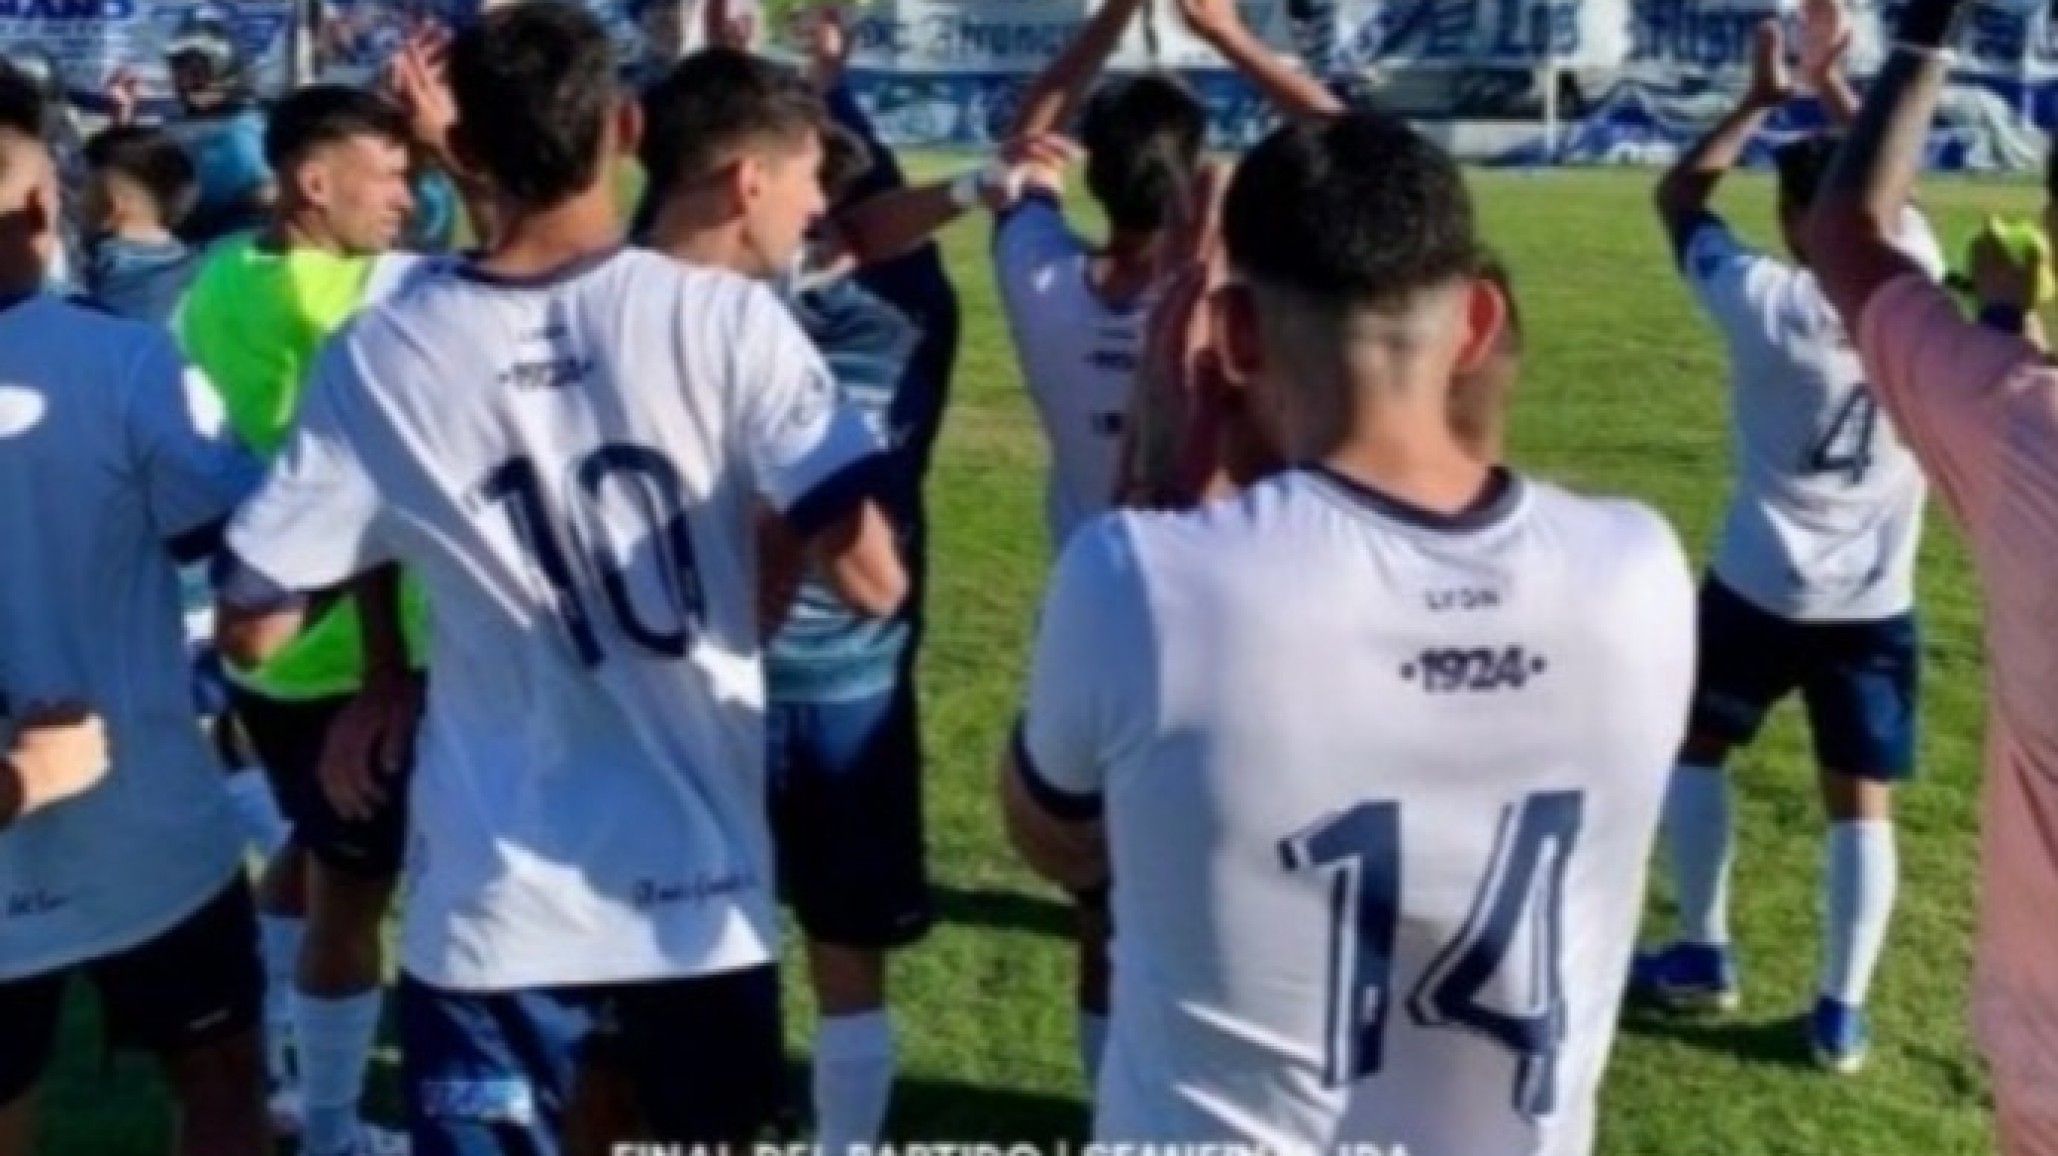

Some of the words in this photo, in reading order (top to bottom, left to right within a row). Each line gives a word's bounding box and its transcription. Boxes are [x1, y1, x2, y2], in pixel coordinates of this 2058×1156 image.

[1803, 381, 1878, 485] 4
[462, 442, 708, 670] 10
[1277, 788, 1587, 1117] 14
